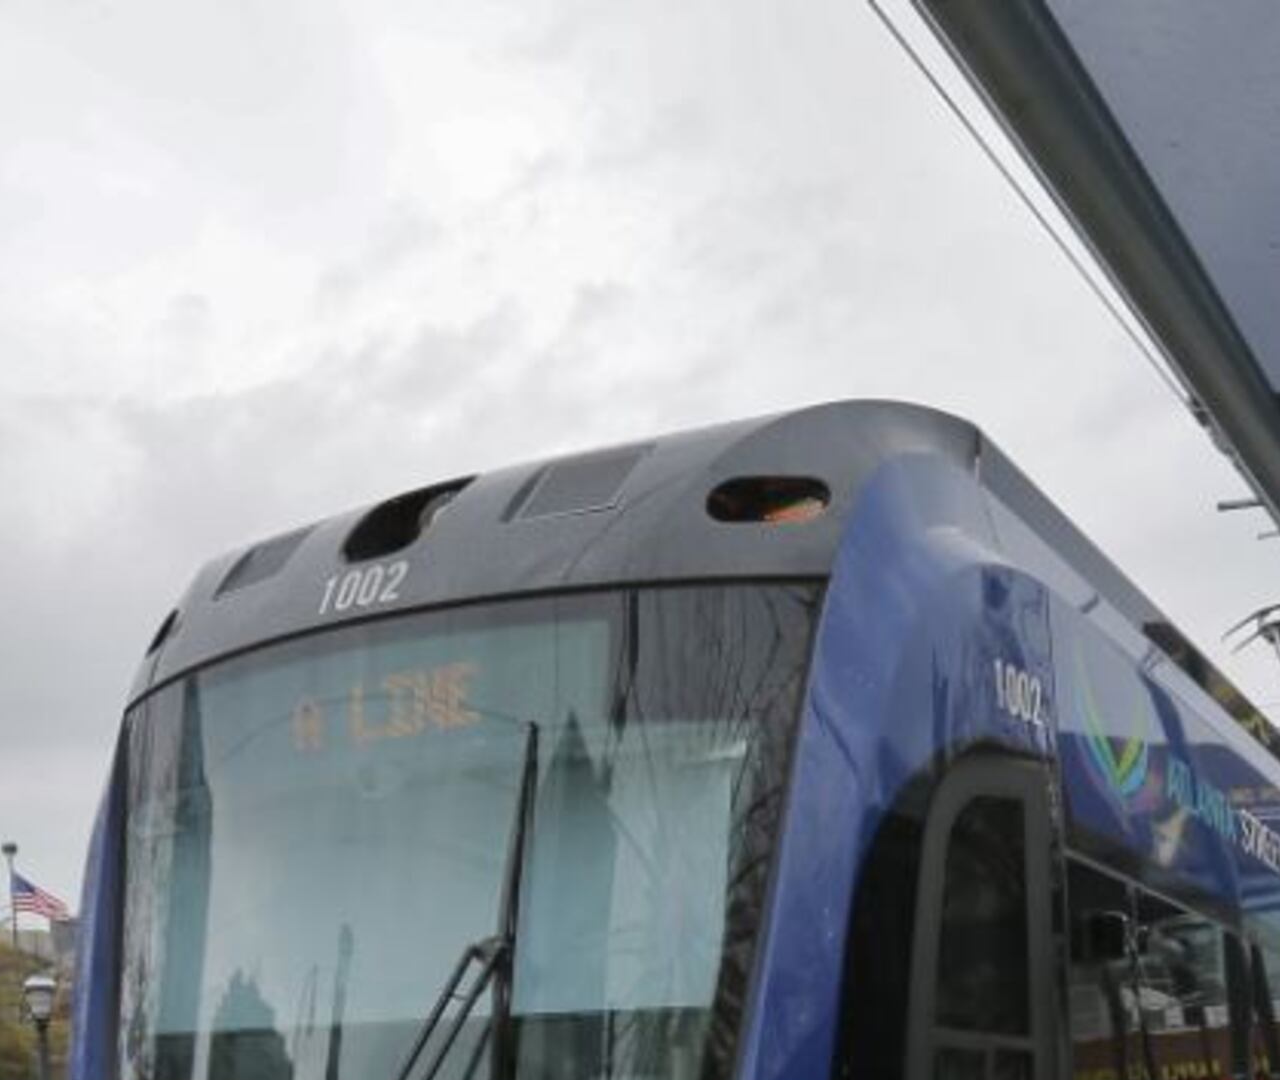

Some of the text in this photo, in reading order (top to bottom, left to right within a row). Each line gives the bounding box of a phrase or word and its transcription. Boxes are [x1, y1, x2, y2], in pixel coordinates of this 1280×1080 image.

[318, 560, 409, 616] 1002
[348, 661, 482, 743] LINE
[993, 658, 1044, 727] 1002
